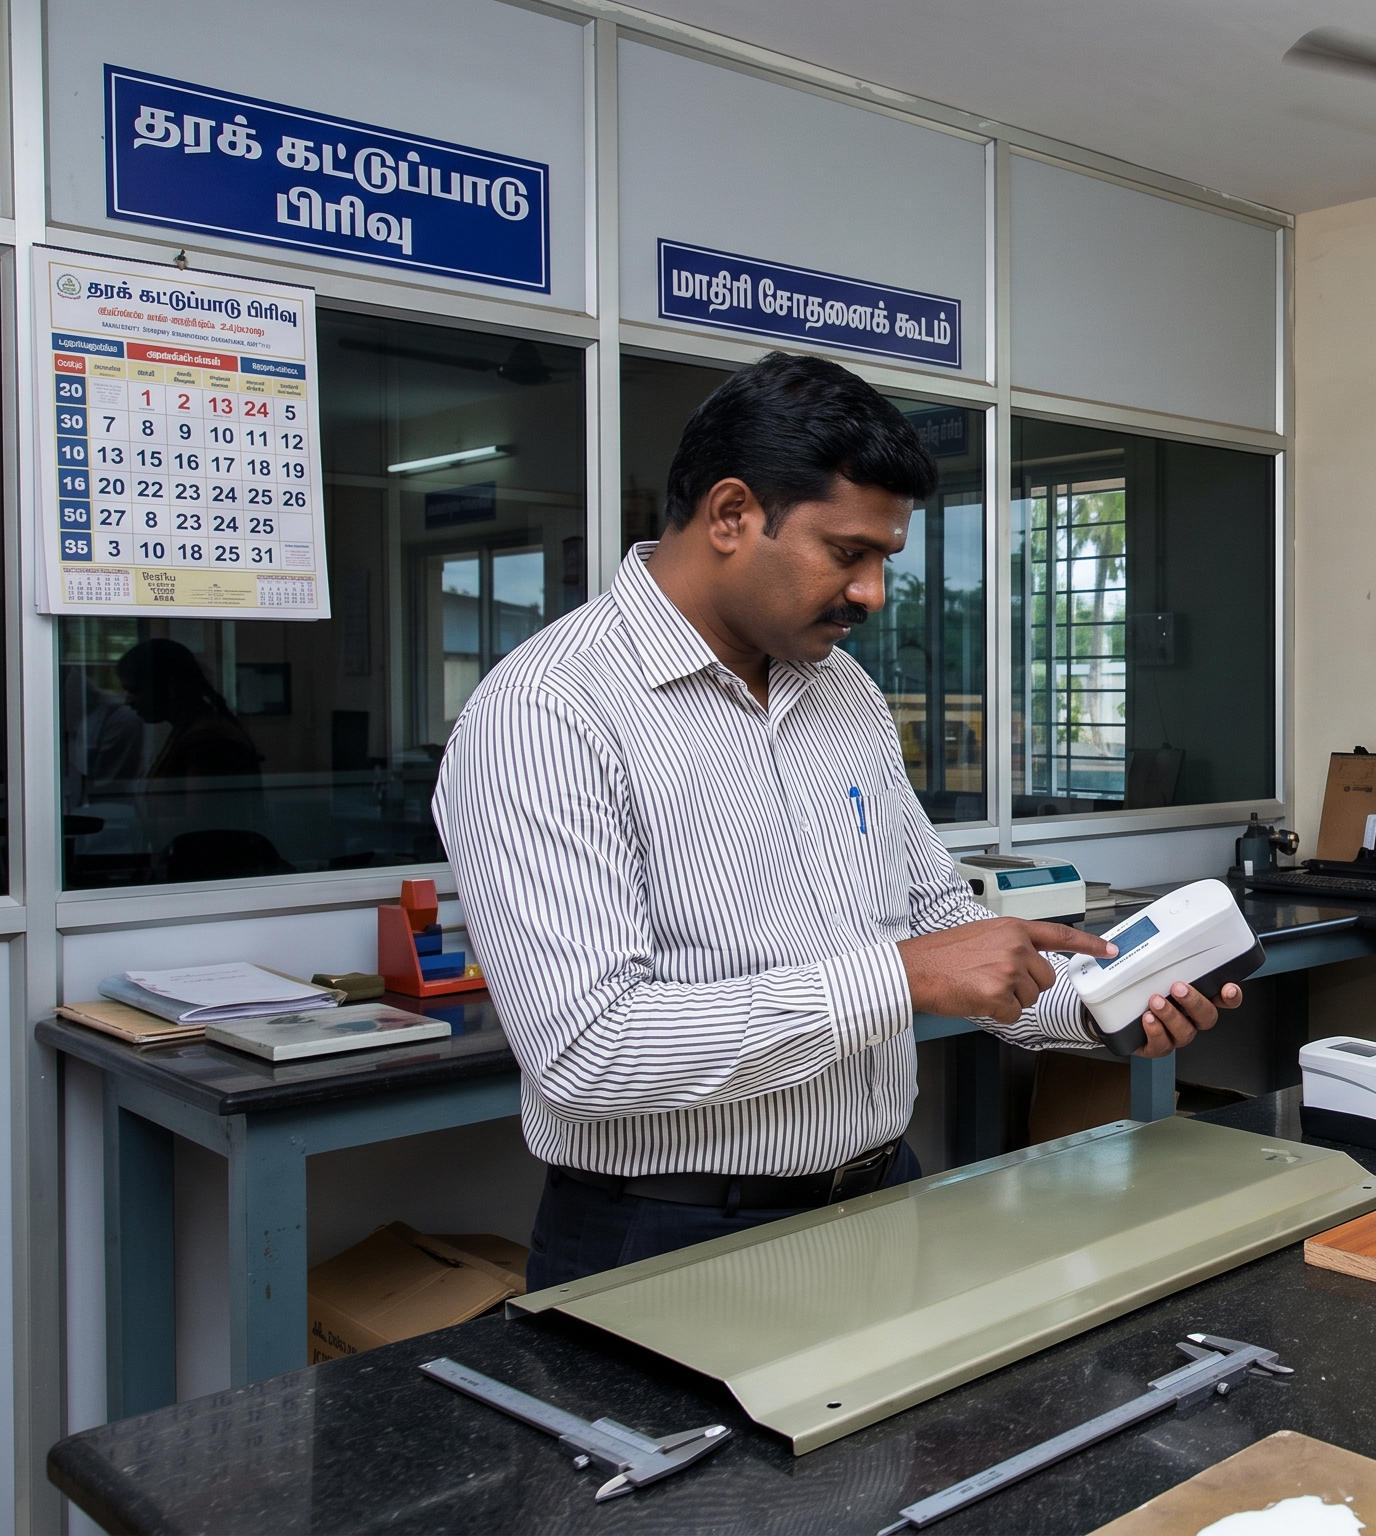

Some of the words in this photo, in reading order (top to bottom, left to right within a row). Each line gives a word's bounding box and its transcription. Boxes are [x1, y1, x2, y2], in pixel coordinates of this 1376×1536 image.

[134, 104, 262, 159] தரக்
[277, 135, 530, 221] கட்டுப்பாடு
[276, 187, 413, 256] பிரிவு
[87, 281, 132, 299] தரக்
[139, 290, 241, 319] கட்டுப்பாடு
[248, 301, 296, 327] பிரிவு
[672, 269, 752, 313] மாதிரி
[758, 278, 890, 332] சோதனைக்
[895, 312, 951, 345] கூடம்
[60, 383, 82, 397] 20
[142, 390, 150, 406] 1
[178, 394, 190, 410] 2
[209, 397, 232, 414] 13
[245, 401, 269, 417] 24
[285, 405, 295, 420] 5
[61, 414, 83, 428] 30
[103, 416, 115, 432] 7
[142, 420, 154, 436] 8
[180, 424, 191, 439] 9
[210, 427, 233, 443] 10
[246, 430, 267, 446] 11
[281, 434, 303, 450] 12
[62, 446, 84, 459] 10
[98, 447, 123, 464] 13
[137, 450, 162, 467] 15
[175, 453, 199, 470] 16
[212, 457, 235, 473] 17
[248, 459, 270, 476] 18
[282, 462, 304, 478] 19
[63, 477, 85, 490] 16
[99, 478, 124, 495] 20
[138, 481, 163, 498] 22
[175, 483, 200, 500] 23
[212, 486, 237, 502] 24
[249, 489, 272, 505] 25
[283, 491, 305, 507] 26
[100, 509, 126, 526] 27
[146, 512, 157, 528] 8
[177, 514, 201, 530] 23
[214, 516, 238, 532] 24
[250, 518, 273, 534] 25
[65, 540, 88, 554] 35
[109, 541, 120, 557] 3
[140, 542, 164, 559] 10
[178, 544, 202, 560] 18
[215, 546, 239, 562] 25
[252, 547, 272, 563] 31
